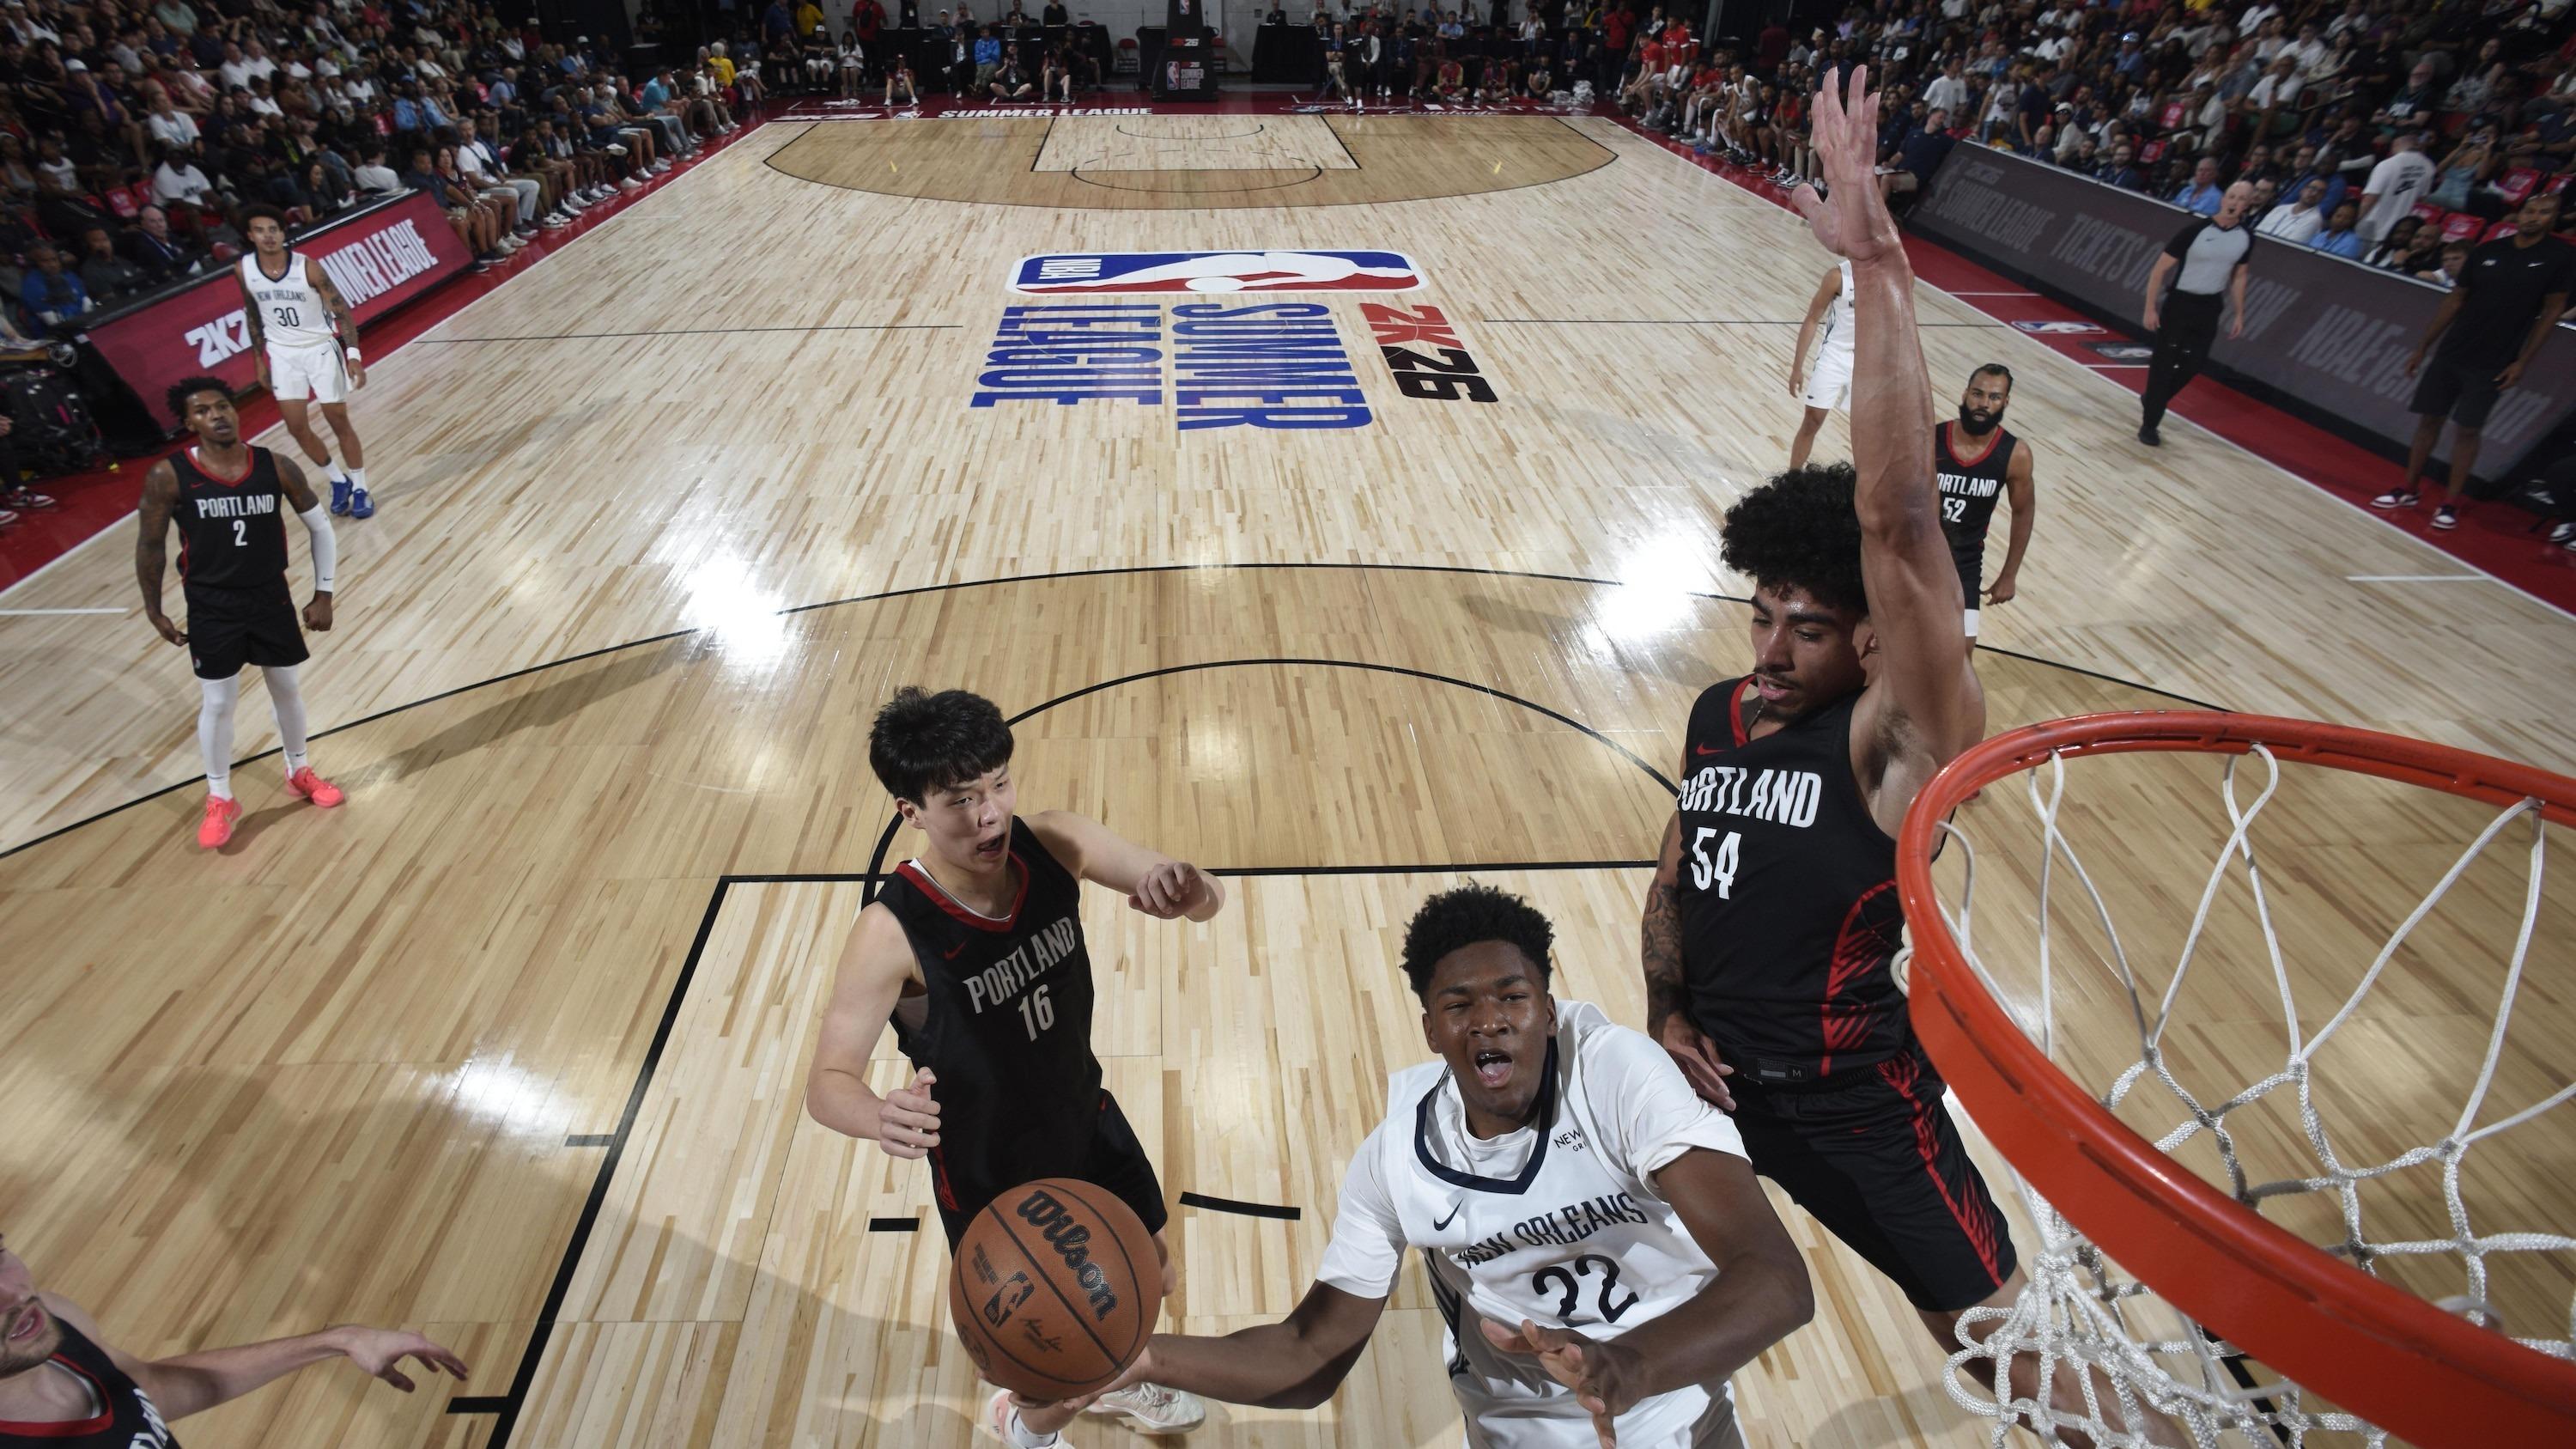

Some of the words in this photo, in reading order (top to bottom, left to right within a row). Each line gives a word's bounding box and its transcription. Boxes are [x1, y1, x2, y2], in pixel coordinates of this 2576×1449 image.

[937, 109, 1054, 118] SUMMER
[1059, 107, 1153, 117] LEAGUE
[364, 218, 439, 286] LEAGUE
[1935, 179, 2007, 234] SUMMER
[1984, 197, 2057, 253] LEAGUE
[2050, 212, 2148, 282] TICKETS
[1042, 258, 1102, 280] NBA
[273, 307, 300, 327] 30
[969, 304, 1163, 408] LEAGUE
[1170, 302, 1374, 430] SUMMER
[1359, 301, 1499, 403] 2K26
[195, 494, 275, 519] PORTLAND
[1937, 472, 1998, 497] ORTLAND
[1942, 497, 1967, 523] 52
[233, 520, 248, 546] 2
[1690, 826, 1742, 900] 54
[962, 916, 1076, 1014] PORTLAND
[1018, 983, 1055, 1042] 16
[1553, 1129, 1582, 1148] NEW
[1017, 1190, 1118, 1321] Wilson
[1457, 1231, 1516, 1269] NEW
[1513, 1191, 1648, 1247] ORLEANS
[1532, 1254, 1639, 1328] 22
